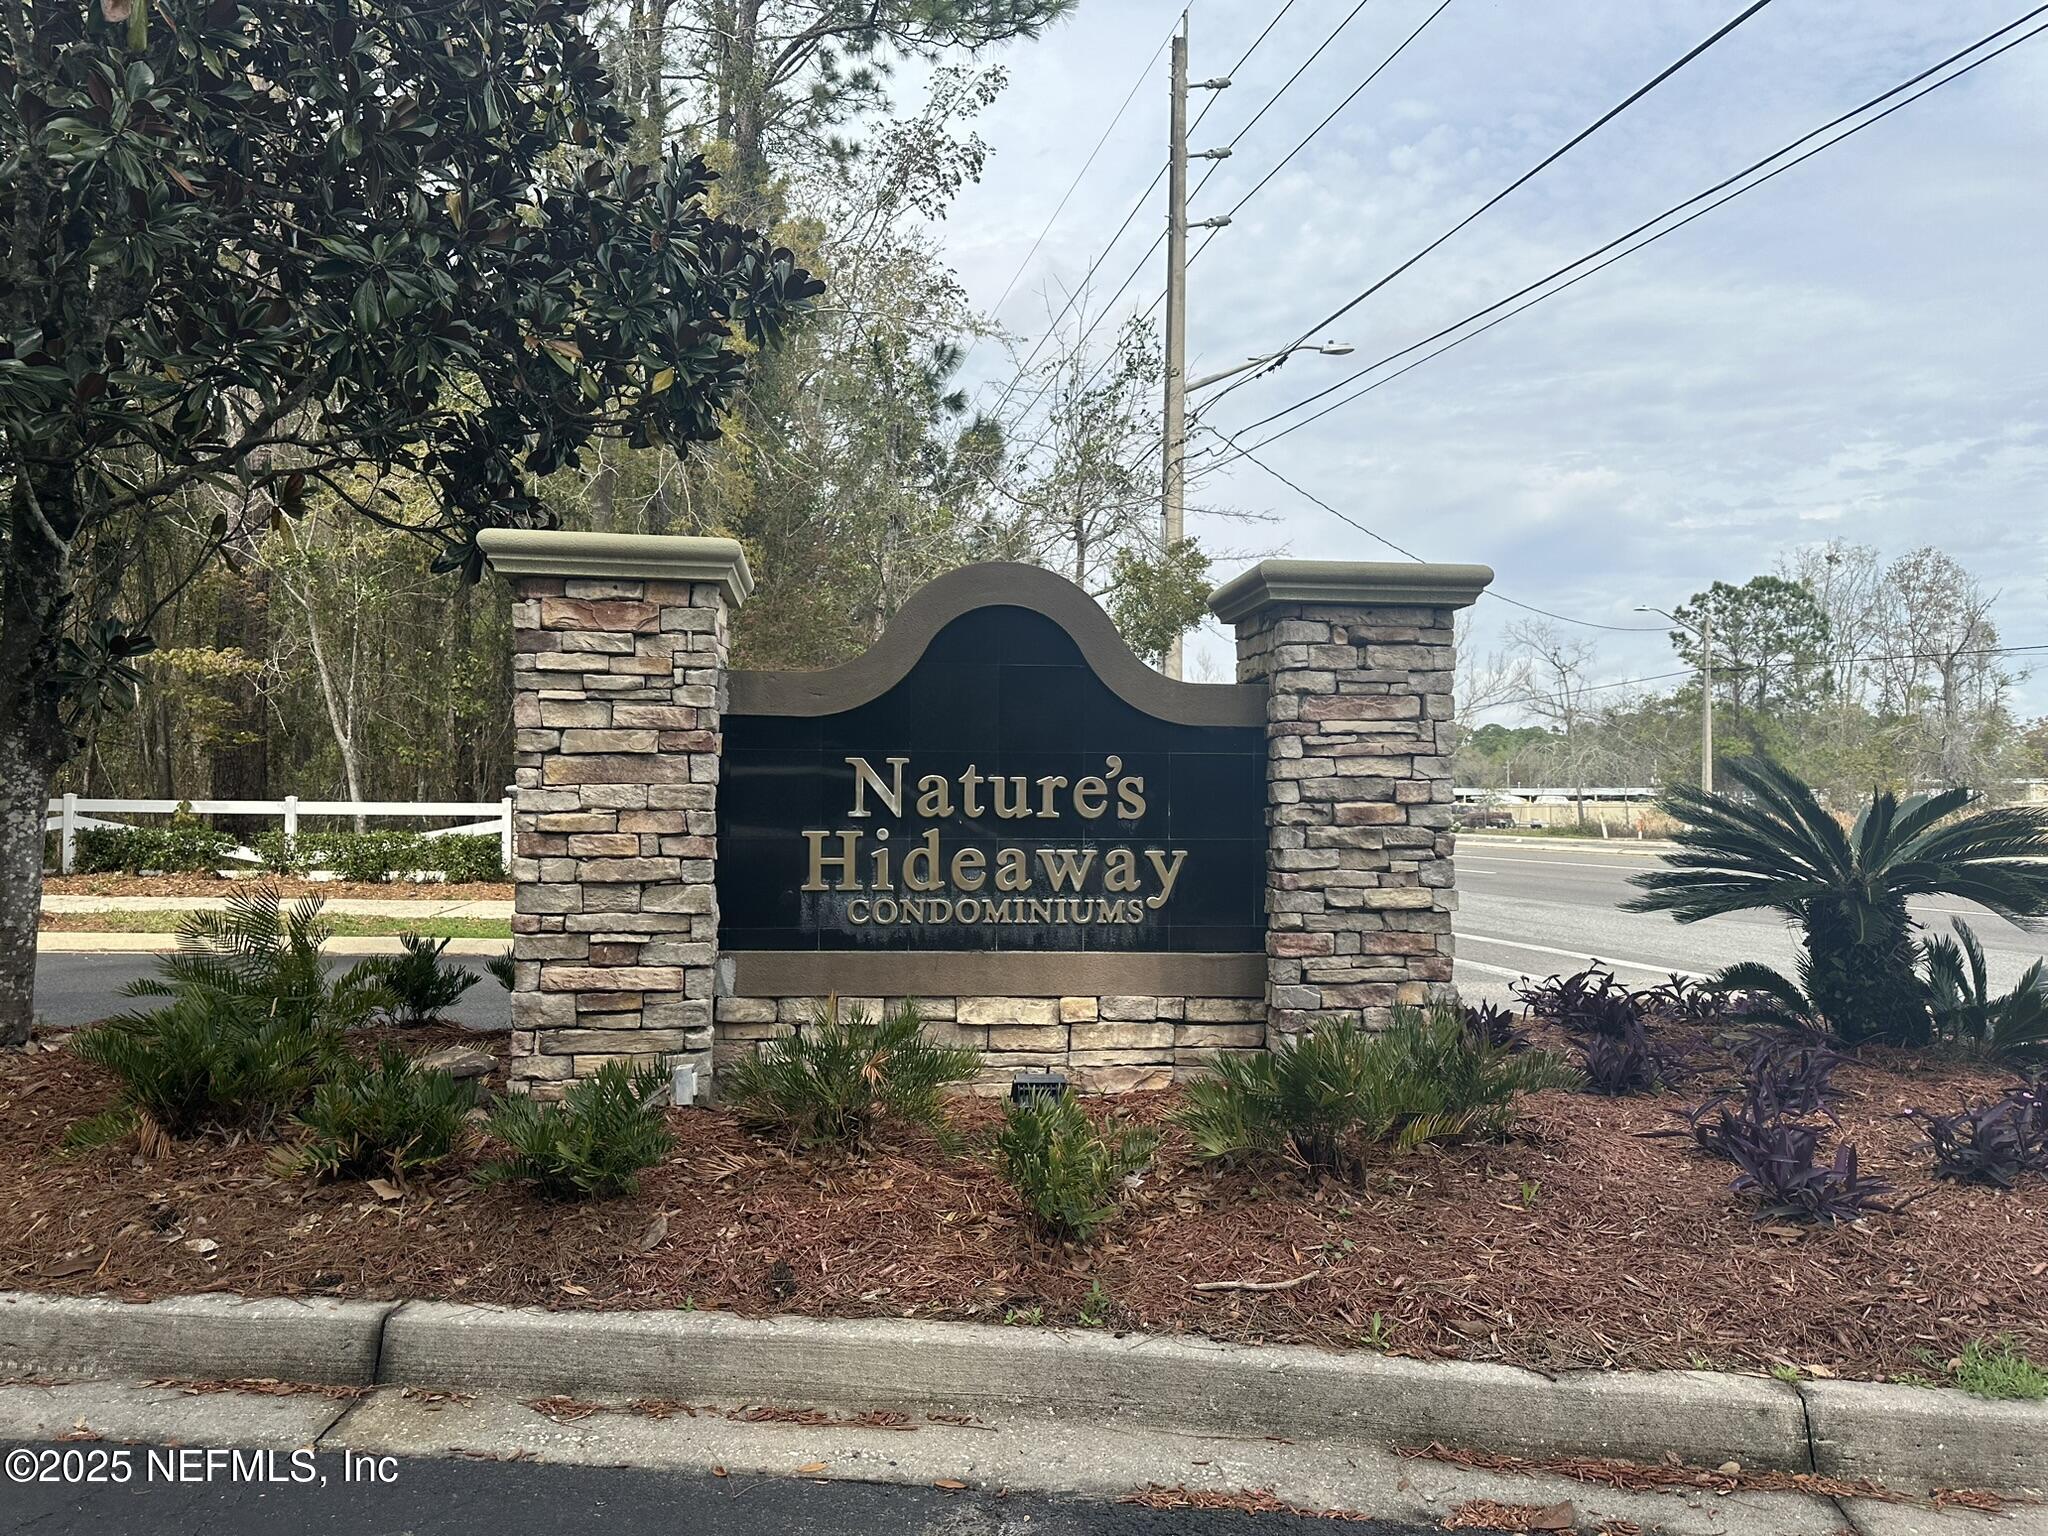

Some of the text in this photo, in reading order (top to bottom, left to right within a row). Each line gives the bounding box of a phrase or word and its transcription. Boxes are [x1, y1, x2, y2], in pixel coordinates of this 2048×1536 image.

[845, 755, 1146, 819] Nature's
[801, 828, 1188, 908] Hideaway
[847, 899, 1144, 925] CONDOMINIUMS
